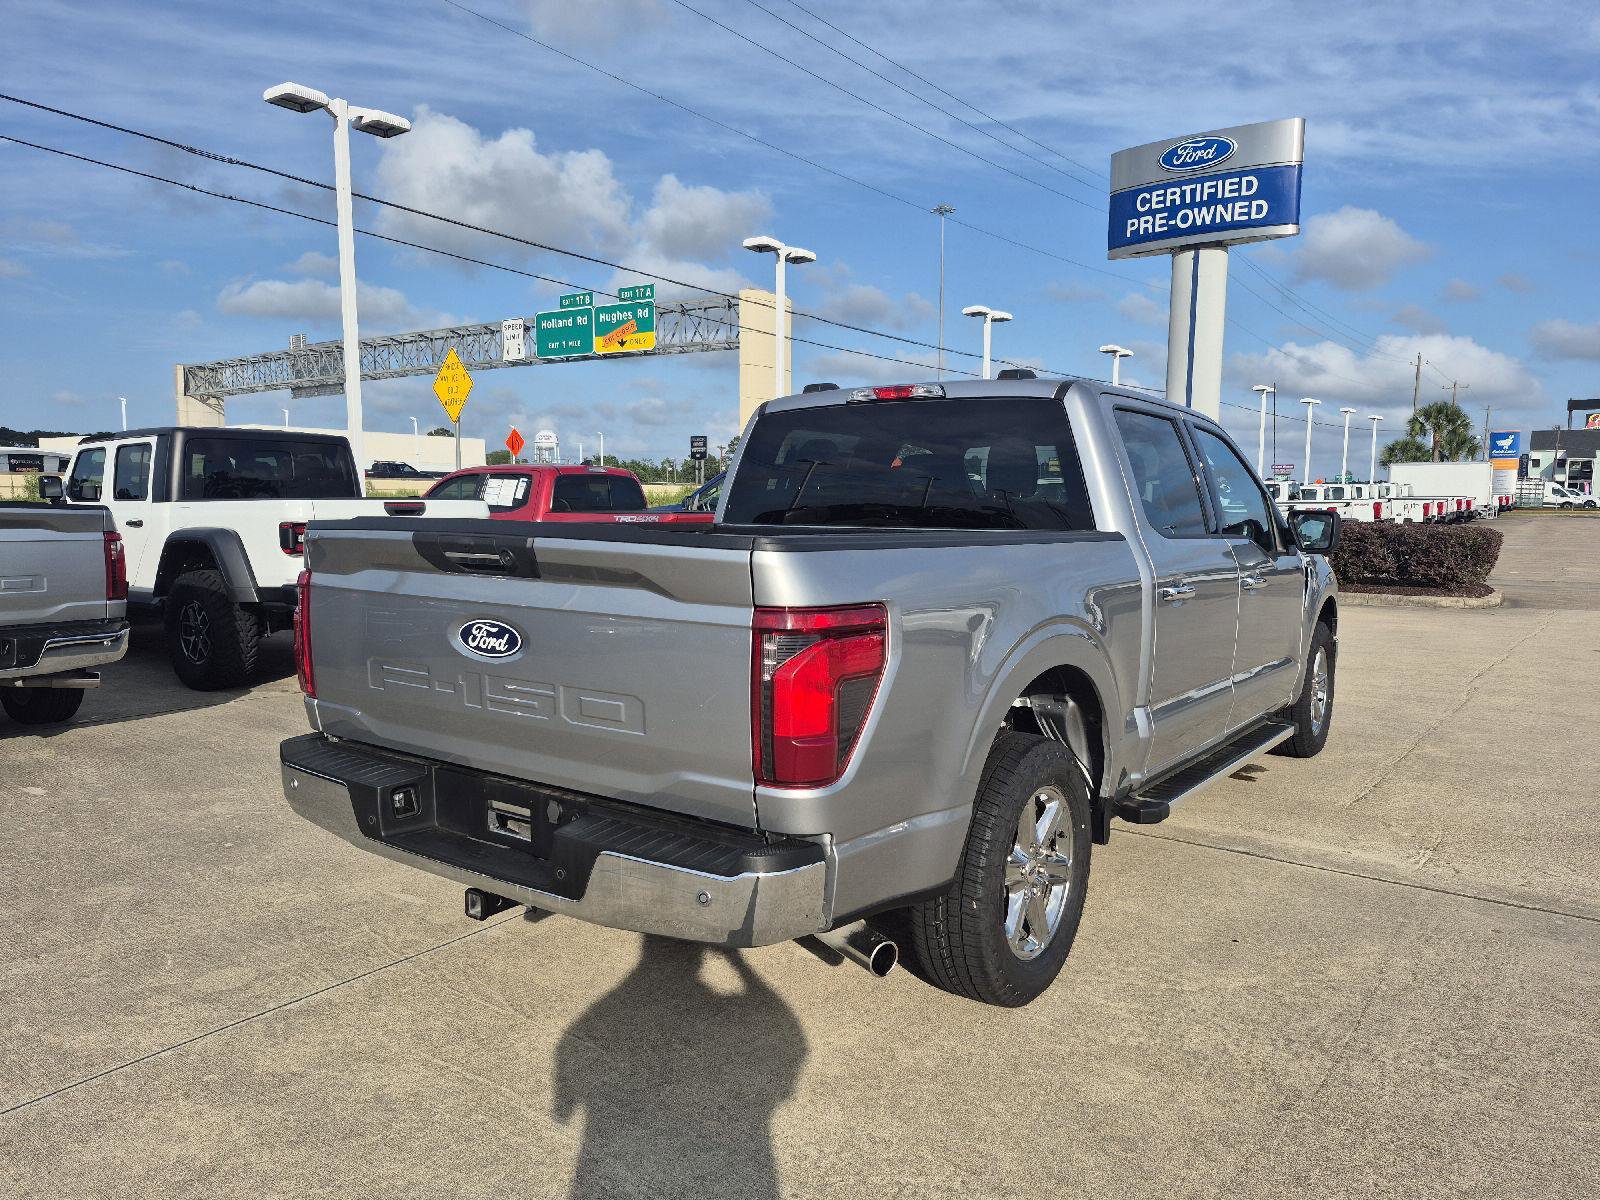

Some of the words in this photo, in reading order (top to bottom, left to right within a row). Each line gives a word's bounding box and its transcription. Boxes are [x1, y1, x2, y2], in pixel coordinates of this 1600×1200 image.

[1173, 141, 1218, 165] Ford
[1136, 175, 1259, 212] CERTIFIED
[1126, 199, 1269, 238] PRE-OWNED
[576, 296, 584, 305] 17
[585, 295, 590, 305] B
[635, 288, 644, 298] 17
[646, 288, 652, 297] A
[541, 317, 573, 330] Holland
[577, 315, 588, 326] Rd
[599, 311, 633, 324] Hughes
[637, 308, 649, 319] Rd
[503, 323, 523, 331] SPEED
[548, 341, 559, 349] EXIT
[568, 339, 581, 347] MILE
[629, 337, 647, 345] ONLY
[613, 515, 637, 523] TRD
[468, 623, 510, 652] Ford
[367, 656, 647, 736] F-150
